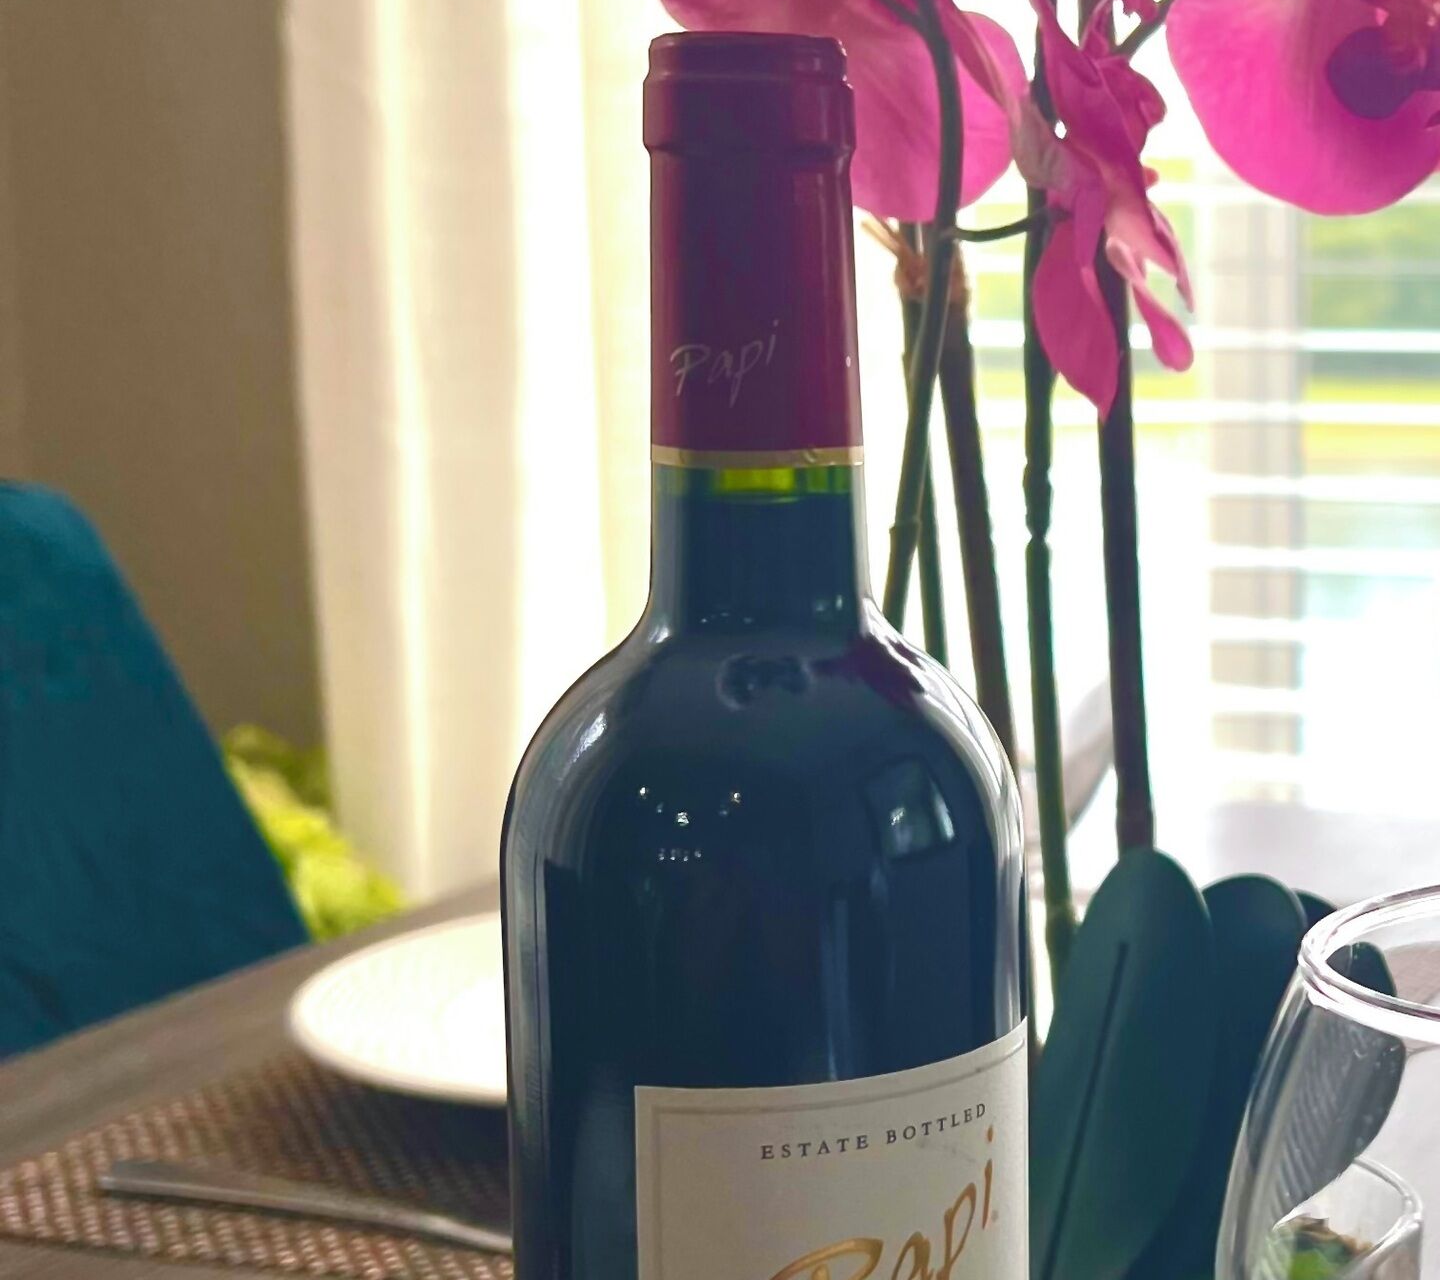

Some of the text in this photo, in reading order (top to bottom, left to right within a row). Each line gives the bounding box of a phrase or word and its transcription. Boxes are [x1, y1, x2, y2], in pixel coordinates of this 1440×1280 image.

[670, 320, 779, 407] Papi
[761, 1103, 987, 1160] ESTATE BOTTLED
